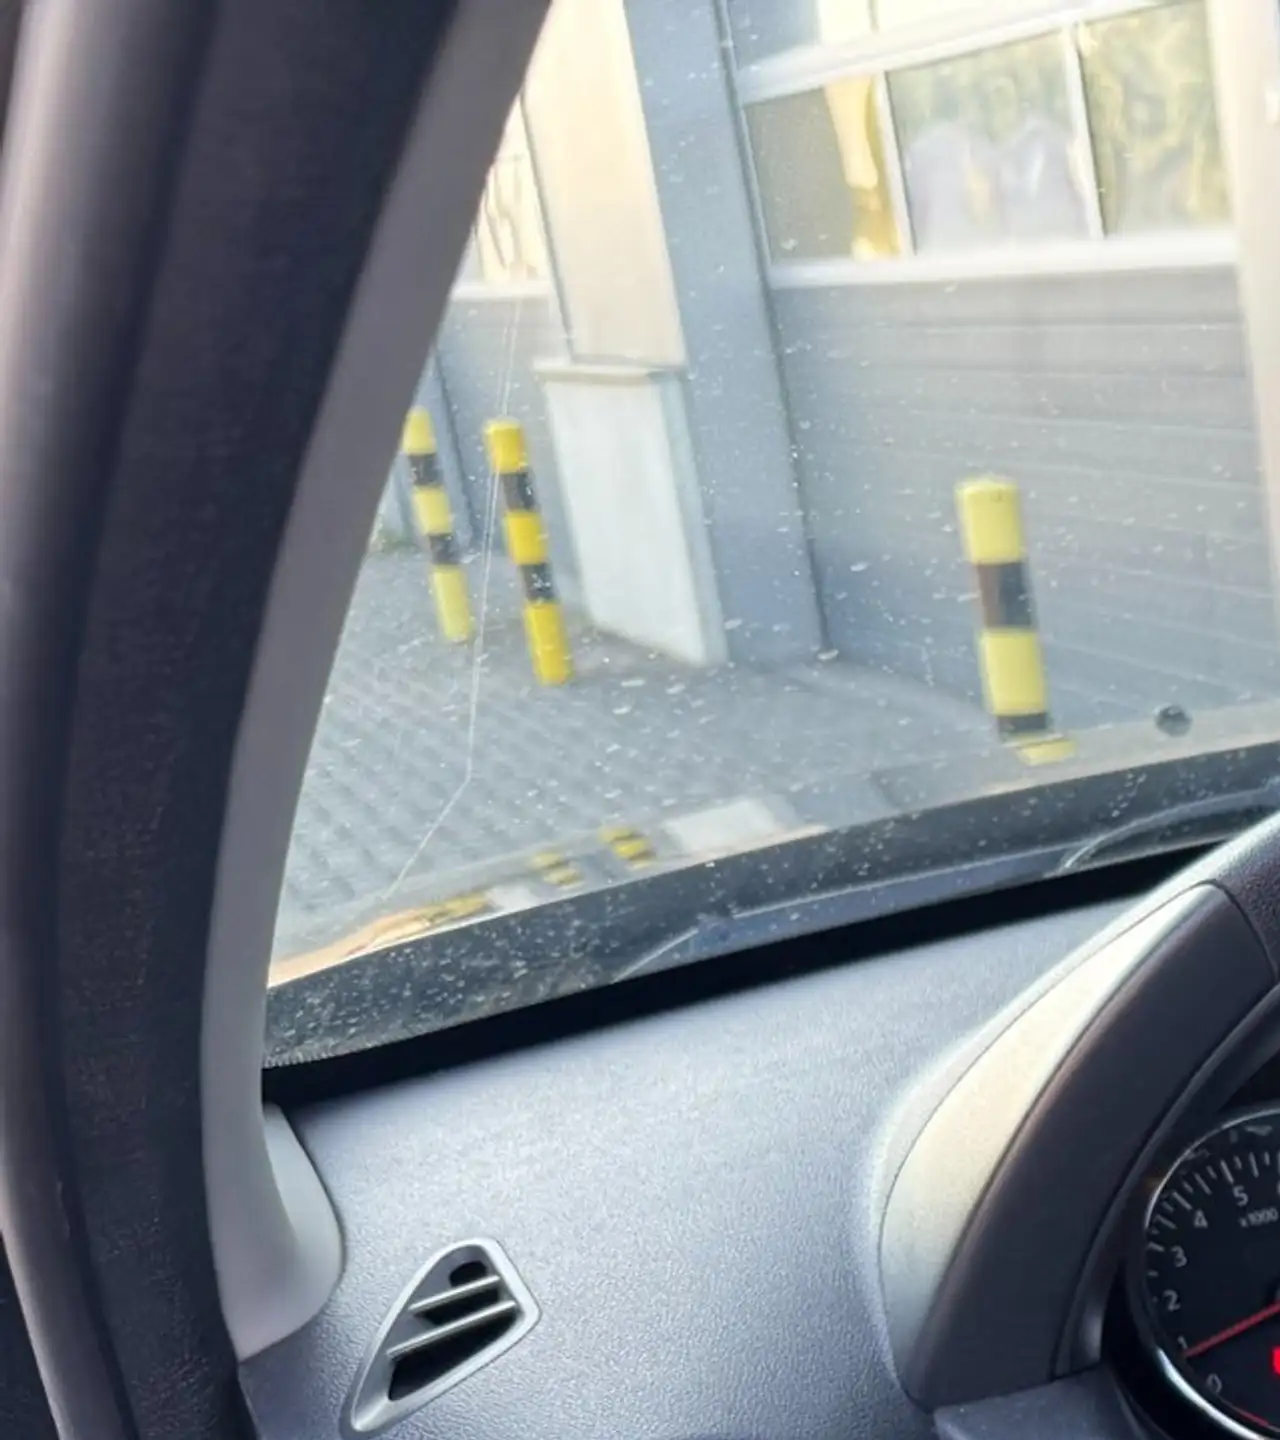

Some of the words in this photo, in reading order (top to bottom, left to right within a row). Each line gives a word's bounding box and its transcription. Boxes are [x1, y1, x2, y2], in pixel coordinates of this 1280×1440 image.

[1233, 1186, 1249, 1206] 5
[1194, 1210, 1208, 1228] 4
[1172, 1246, 1187, 1267] 3
[1164, 1290, 1180, 1311] 2
[1178, 1336, 1188, 1350] 1
[1206, 1374, 1222, 1394] 0
